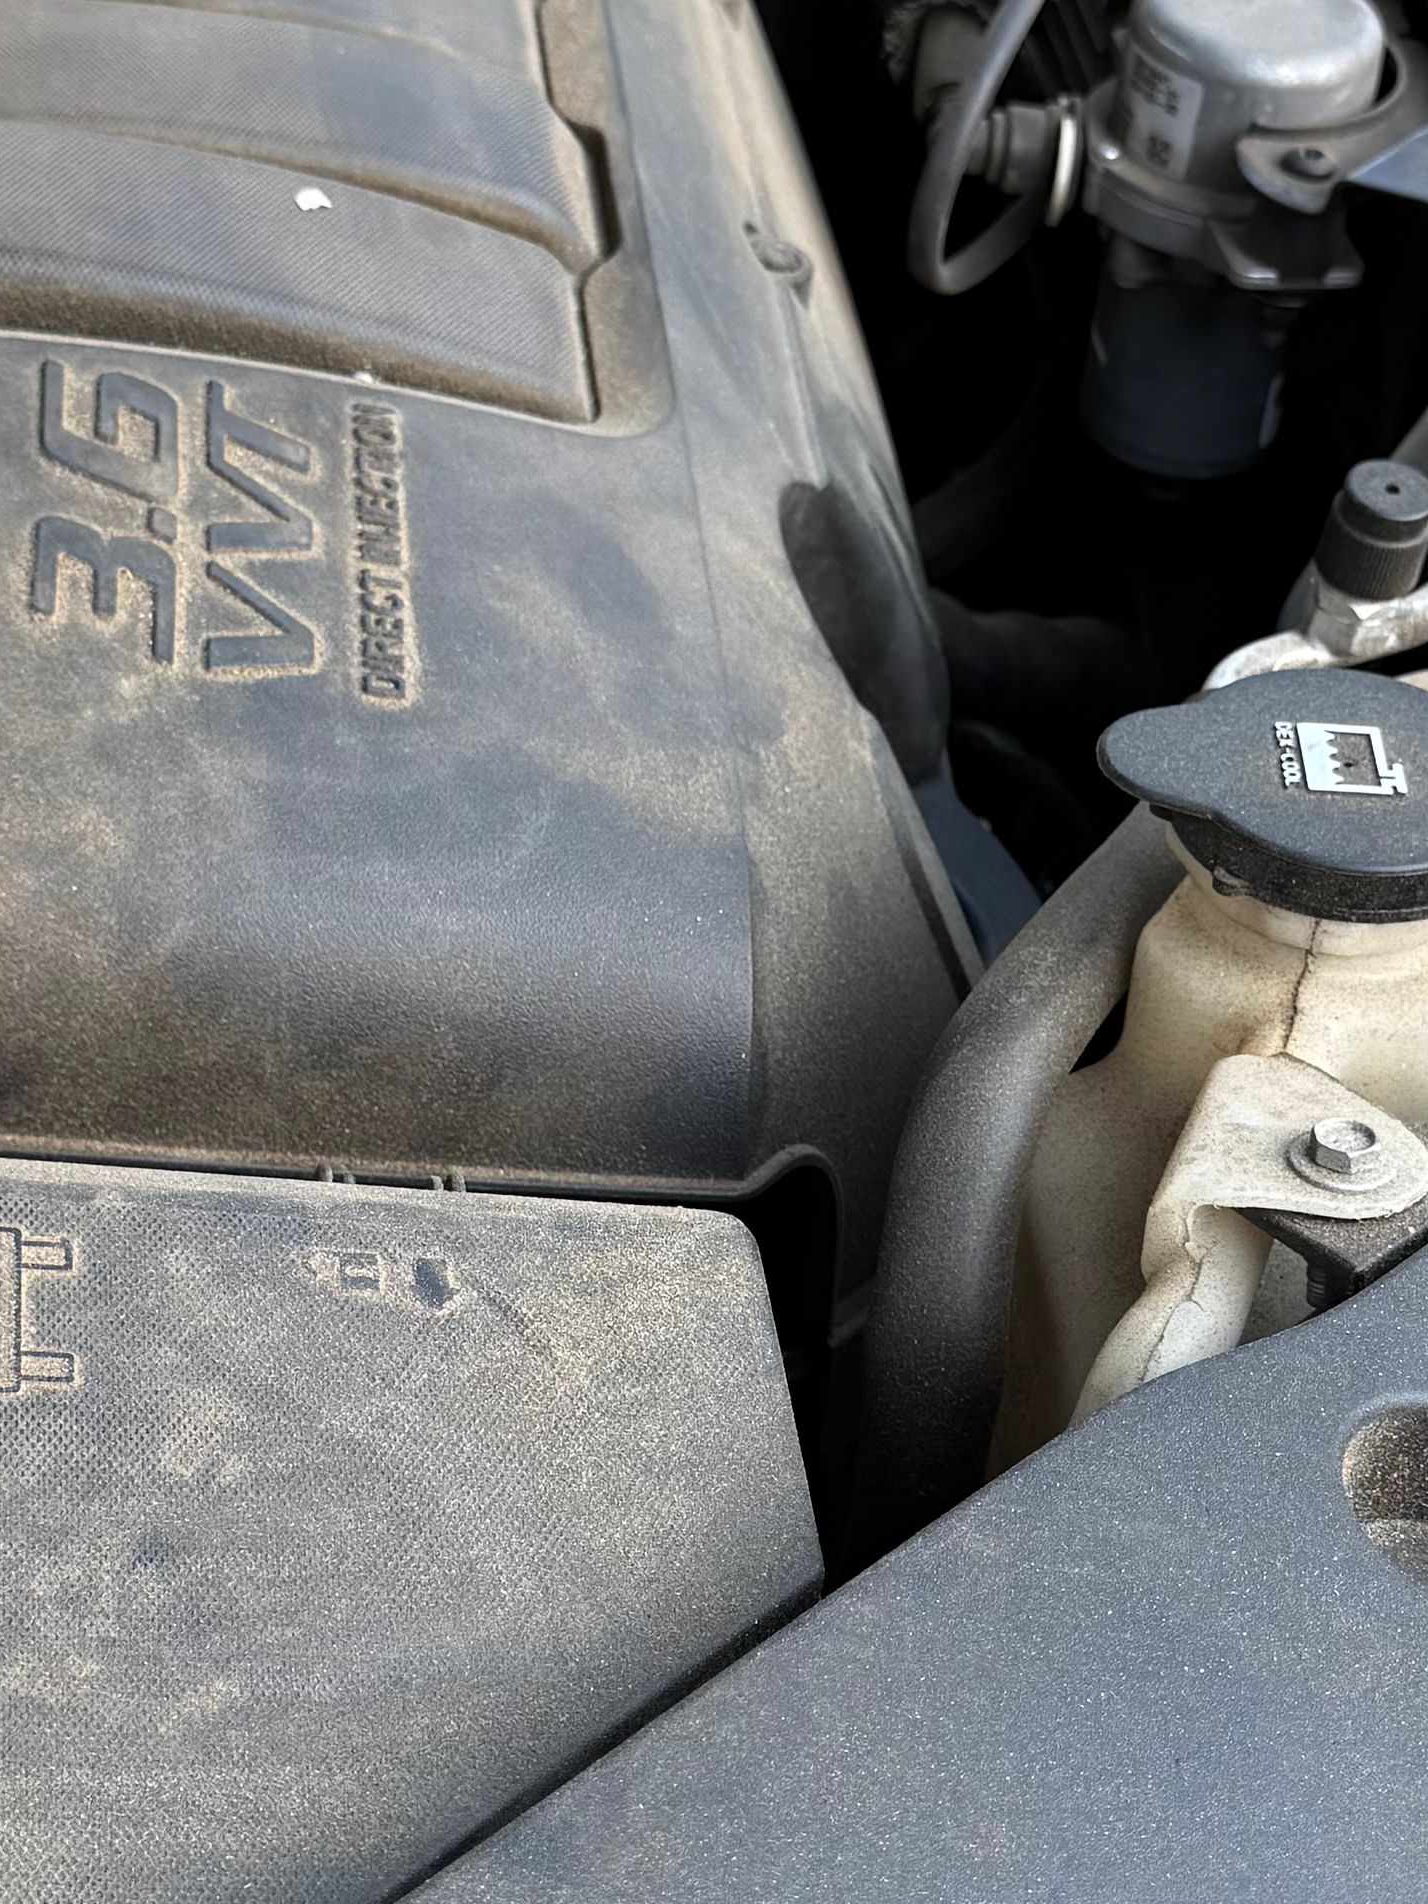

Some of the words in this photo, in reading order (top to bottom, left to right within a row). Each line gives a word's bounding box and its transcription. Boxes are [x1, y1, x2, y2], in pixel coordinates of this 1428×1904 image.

[32, 359, 178, 664] 3.6
[207, 379, 316, 670] VVT
[351, 401, 401, 566] INJECTION
[357, 569, 406, 698] DIRECT
[1273, 721, 1301, 788] DEX-COOL
